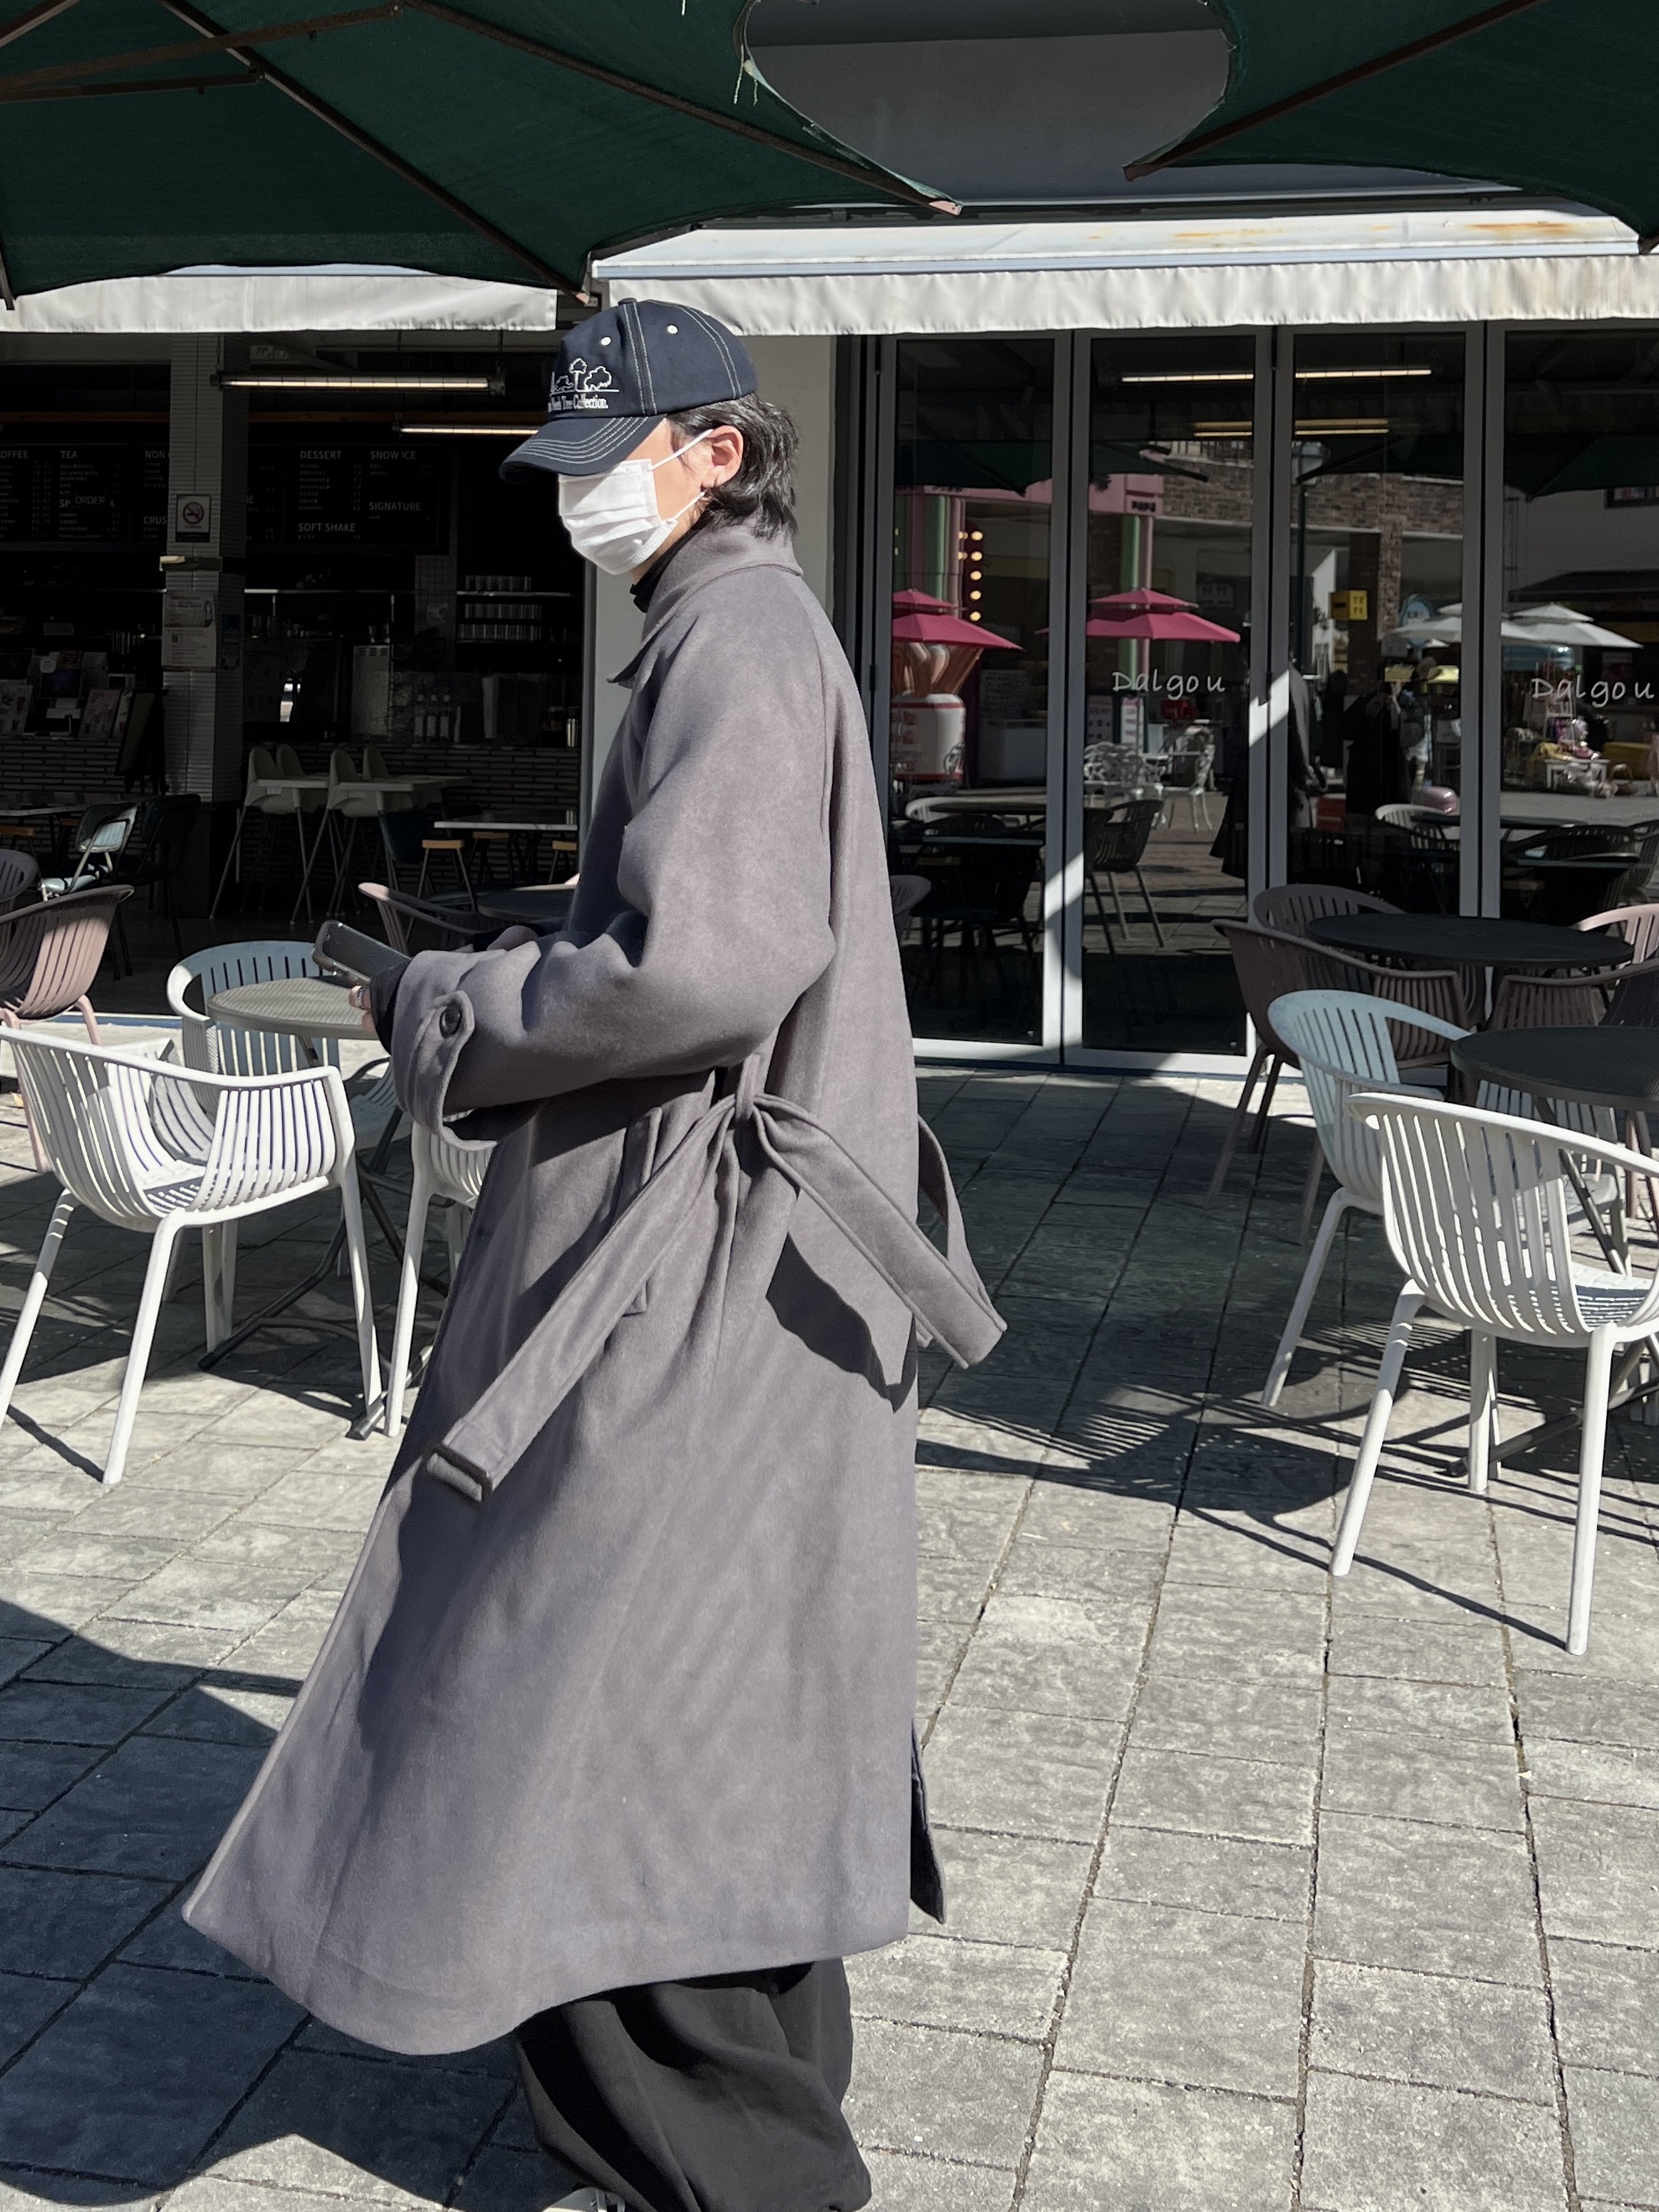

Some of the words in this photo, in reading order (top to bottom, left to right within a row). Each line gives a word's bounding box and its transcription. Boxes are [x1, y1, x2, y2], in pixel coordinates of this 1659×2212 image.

[0, 450, 29, 459] OFFEE
[60, 450, 78, 459] TEA
[144, 450, 165, 459] NON
[299, 450, 341, 460] DESSERT
[370, 450, 399, 460] SNOW
[401, 450, 417, 460] ICE
[75, 496, 106, 505] ORDER
[368, 502, 422, 511] SIGNATURE
[142, 516, 168, 525] CRUS
[298, 523, 322, 533] SOFT
[325, 523, 357, 533] SHAKE
